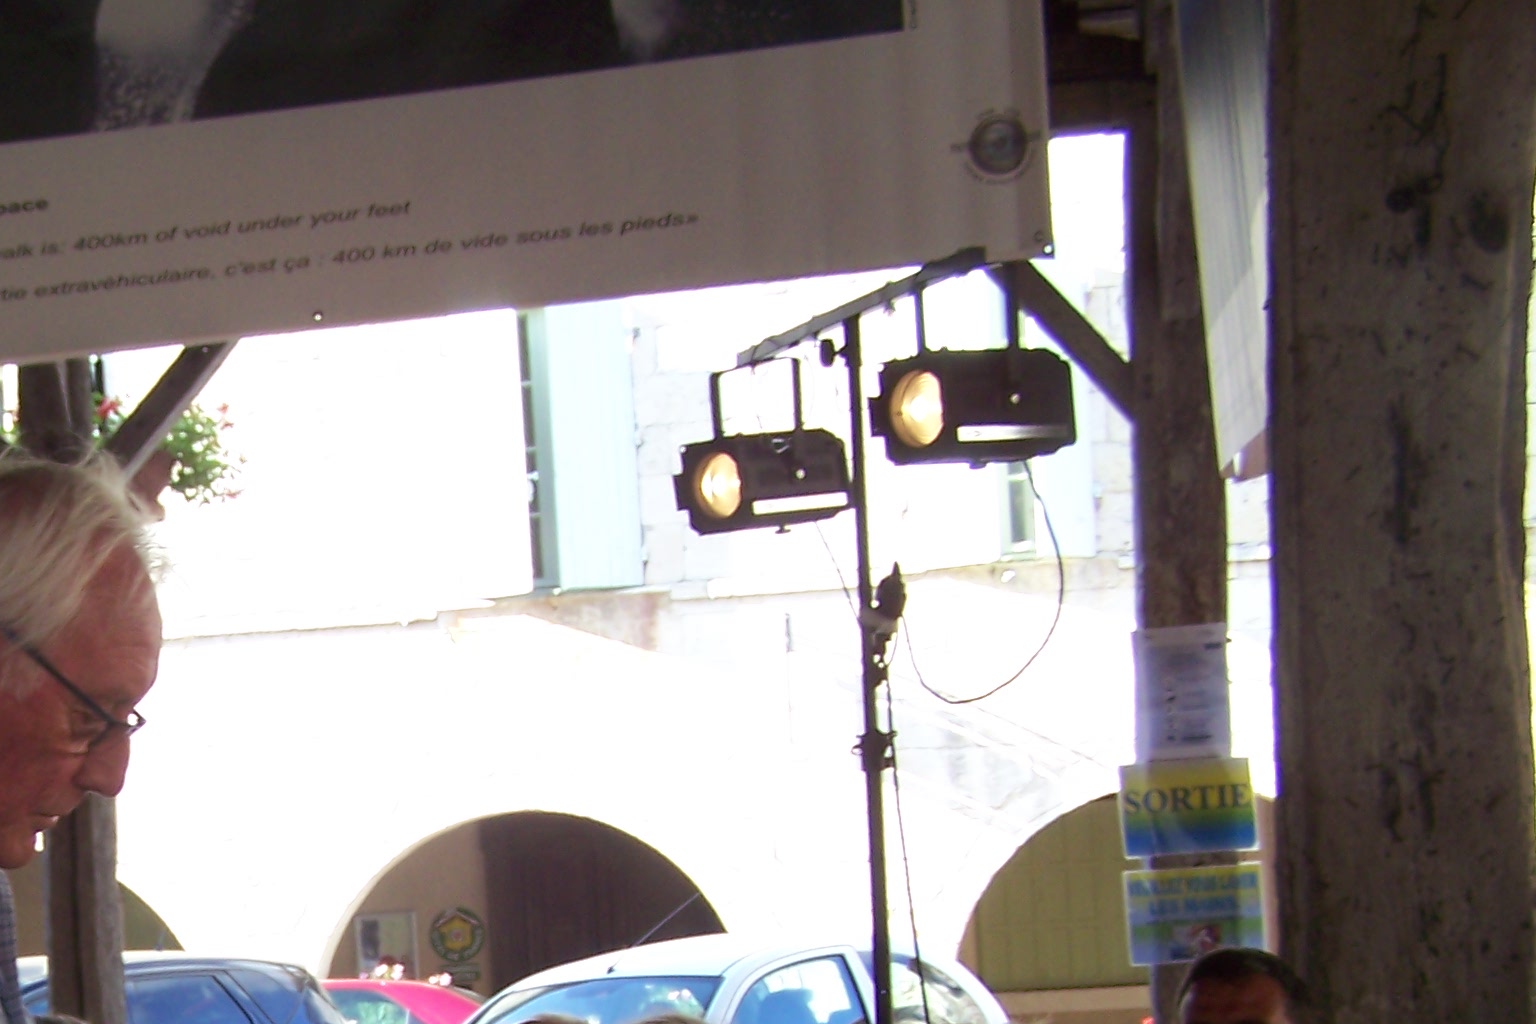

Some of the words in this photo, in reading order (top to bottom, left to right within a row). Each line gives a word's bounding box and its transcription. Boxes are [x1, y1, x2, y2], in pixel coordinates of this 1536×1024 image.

[155, 225, 178, 242] of
[184, 219, 232, 239] void
[237, 214, 304, 233] under
[311, 208, 361, 229] your
[368, 201, 411, 218] feet
[224, 257, 277, 276] c'est
[284, 255, 311, 274] ça
[333, 247, 376, 263] 400
[383, 245, 417, 259] km
[424, 238, 453, 255] de
[460, 232, 509, 250] vide
[516, 225, 572, 245] sous
[578, 220, 614, 237] les
[1124, 783, 1249, 815] SORTIE
